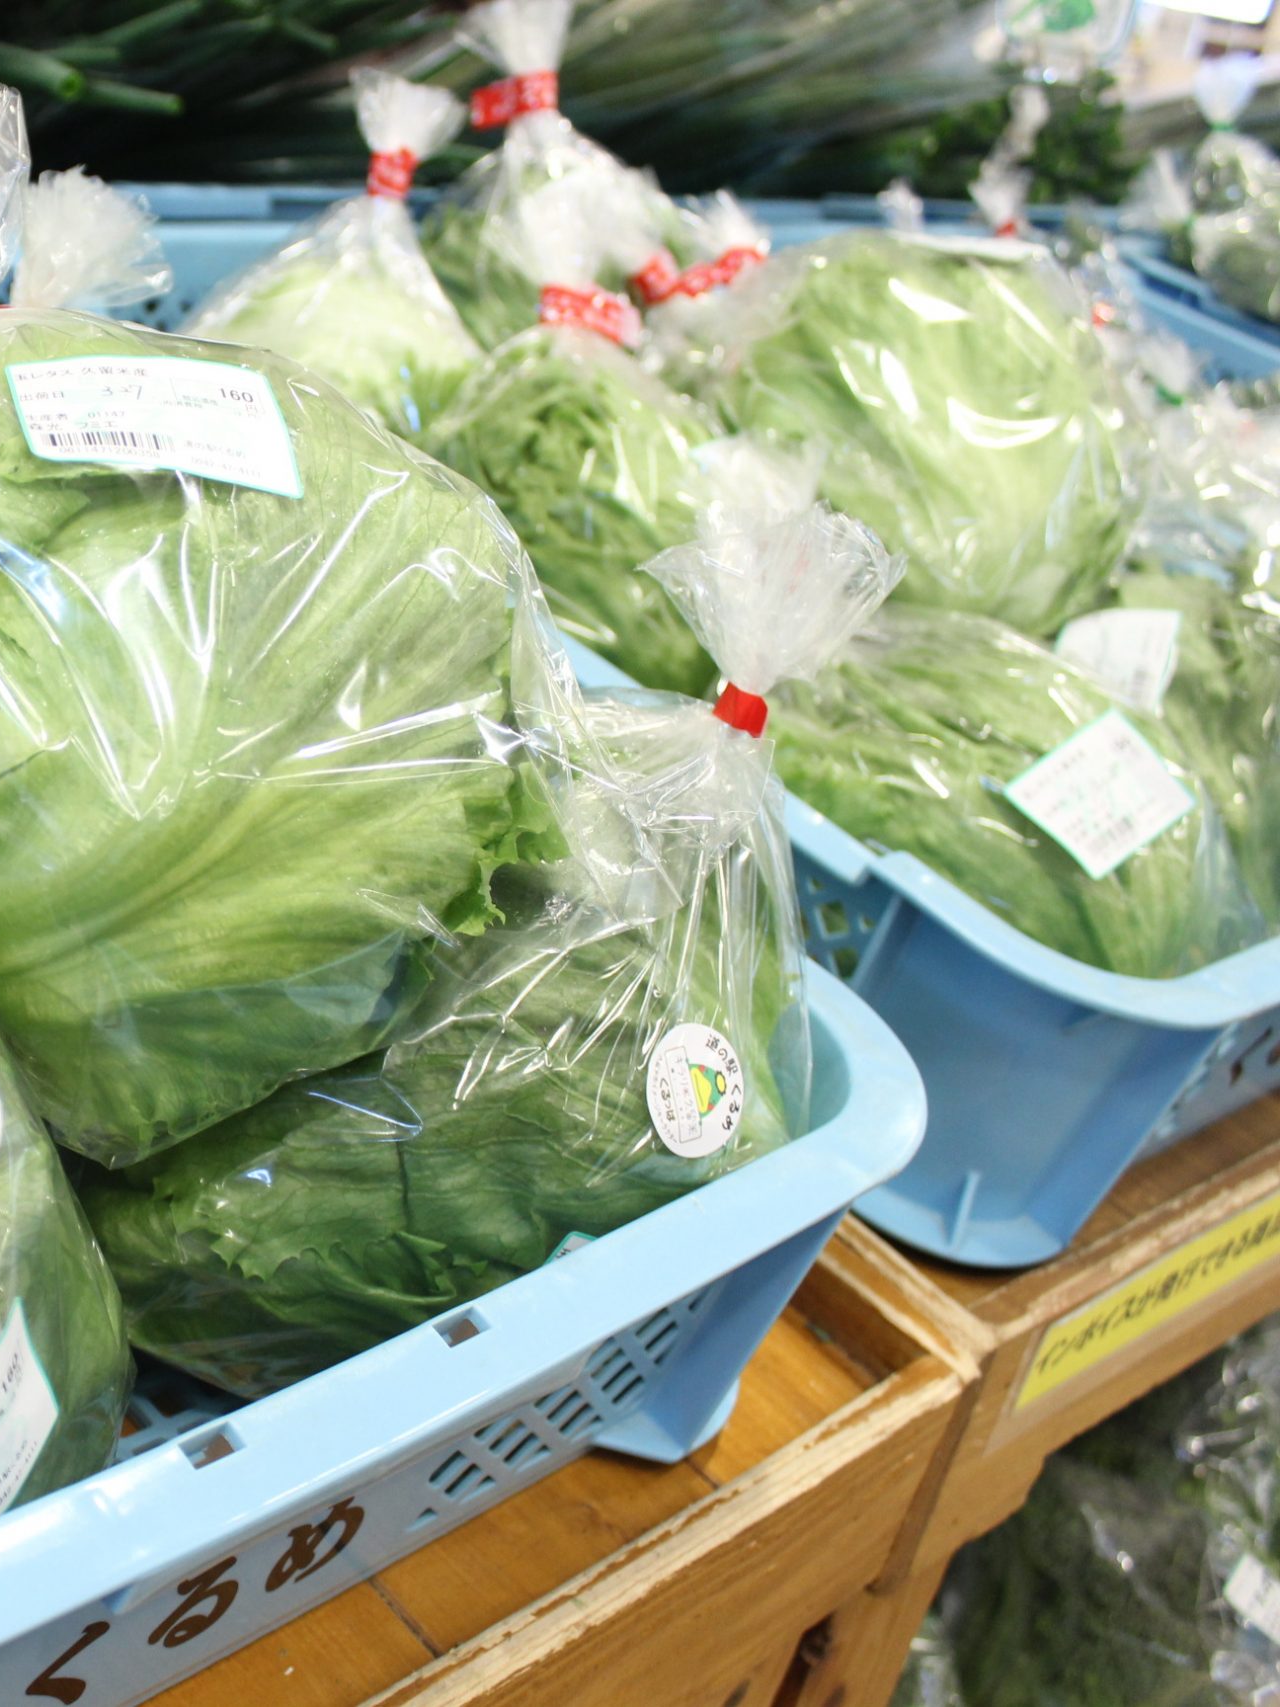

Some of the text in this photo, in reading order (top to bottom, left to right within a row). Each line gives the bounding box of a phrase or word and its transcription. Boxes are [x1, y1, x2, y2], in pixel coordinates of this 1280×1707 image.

[219, 386, 255, 404] 160
[25, 1496, 365, 1706] くるめ
